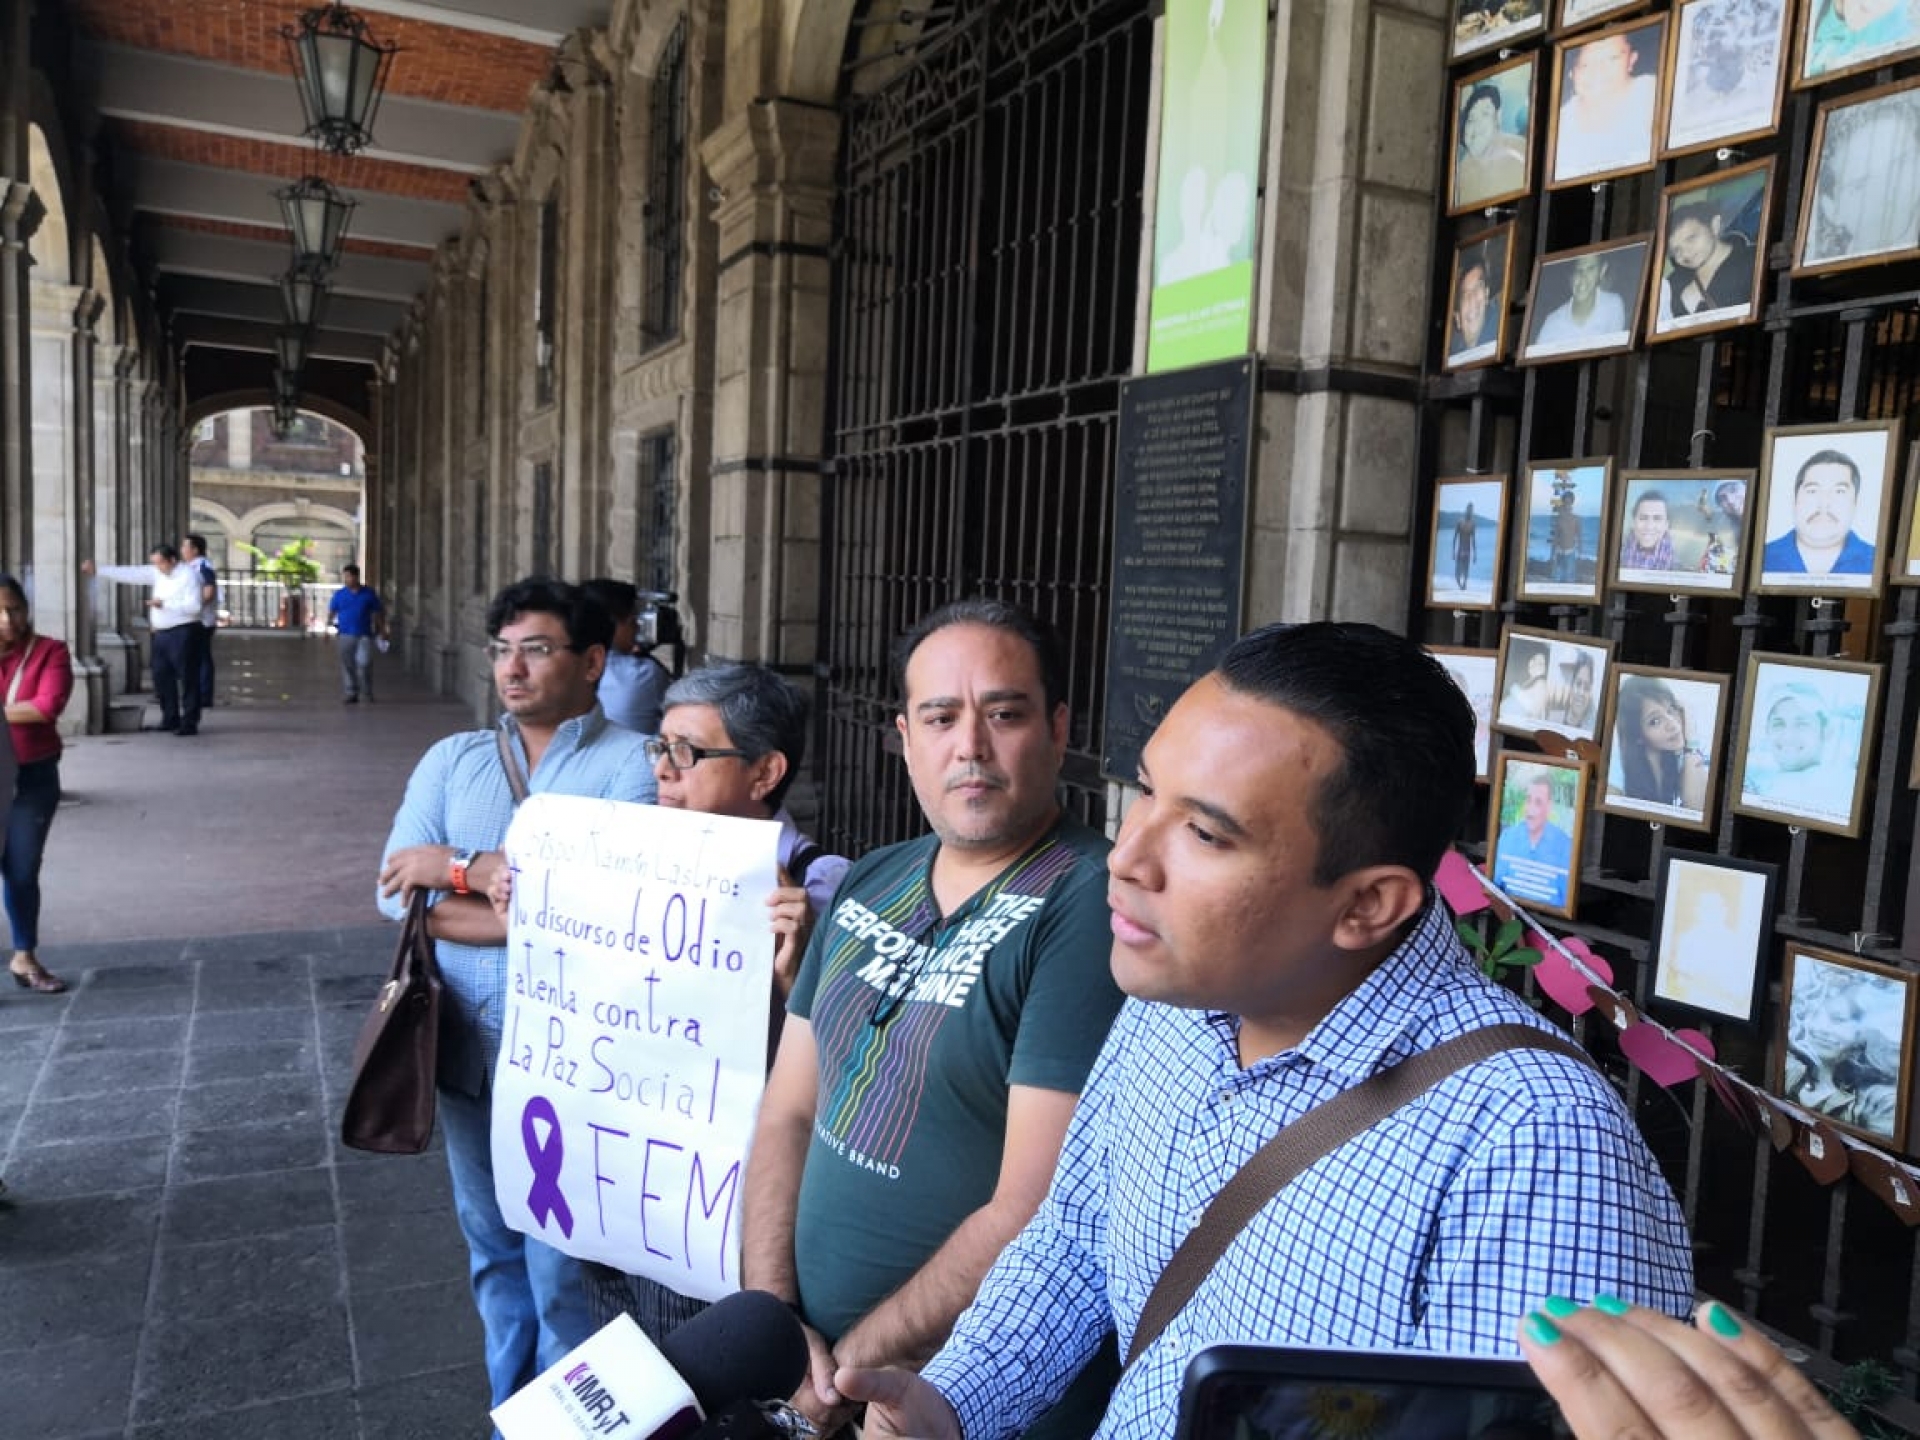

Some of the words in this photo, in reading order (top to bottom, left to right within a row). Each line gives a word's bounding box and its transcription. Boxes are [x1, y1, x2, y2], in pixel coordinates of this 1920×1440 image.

[535, 868, 617, 947] discurso
[623, 887, 650, 955] de
[662, 893, 744, 972] Odio
[514, 941, 577, 1014] atenta
[593, 968, 703, 1046] contra
[509, 1004, 533, 1073] La
[541, 1016, 579, 1088] Paz
[589, 1036, 721, 1124] Social
[587, 1121, 740, 1282] FEM
[848, 1149, 901, 1179] BRAND
